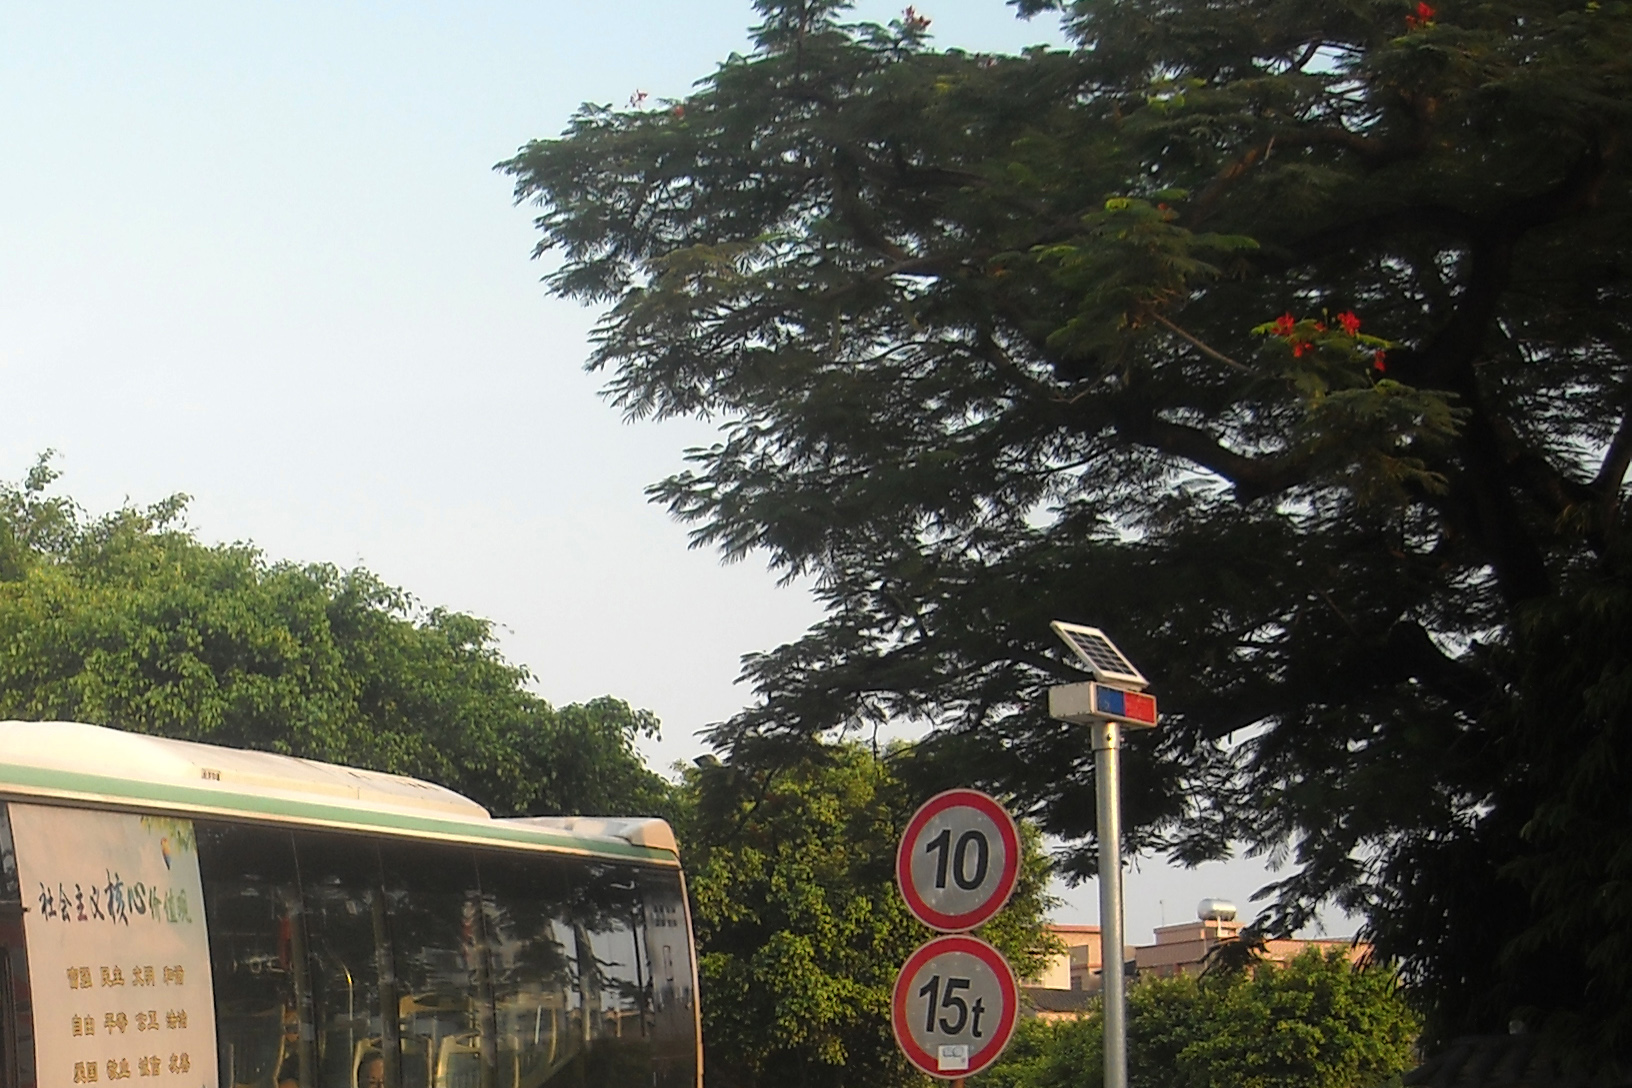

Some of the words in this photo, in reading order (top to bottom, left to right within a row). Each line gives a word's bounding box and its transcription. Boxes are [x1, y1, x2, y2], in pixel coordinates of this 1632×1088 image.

[925, 829, 989, 891] 10
[39, 868, 192, 926] 社会主义核心价值观
[72, 1014, 95, 1036] 自由
[919, 975, 985, 1038] 15t
